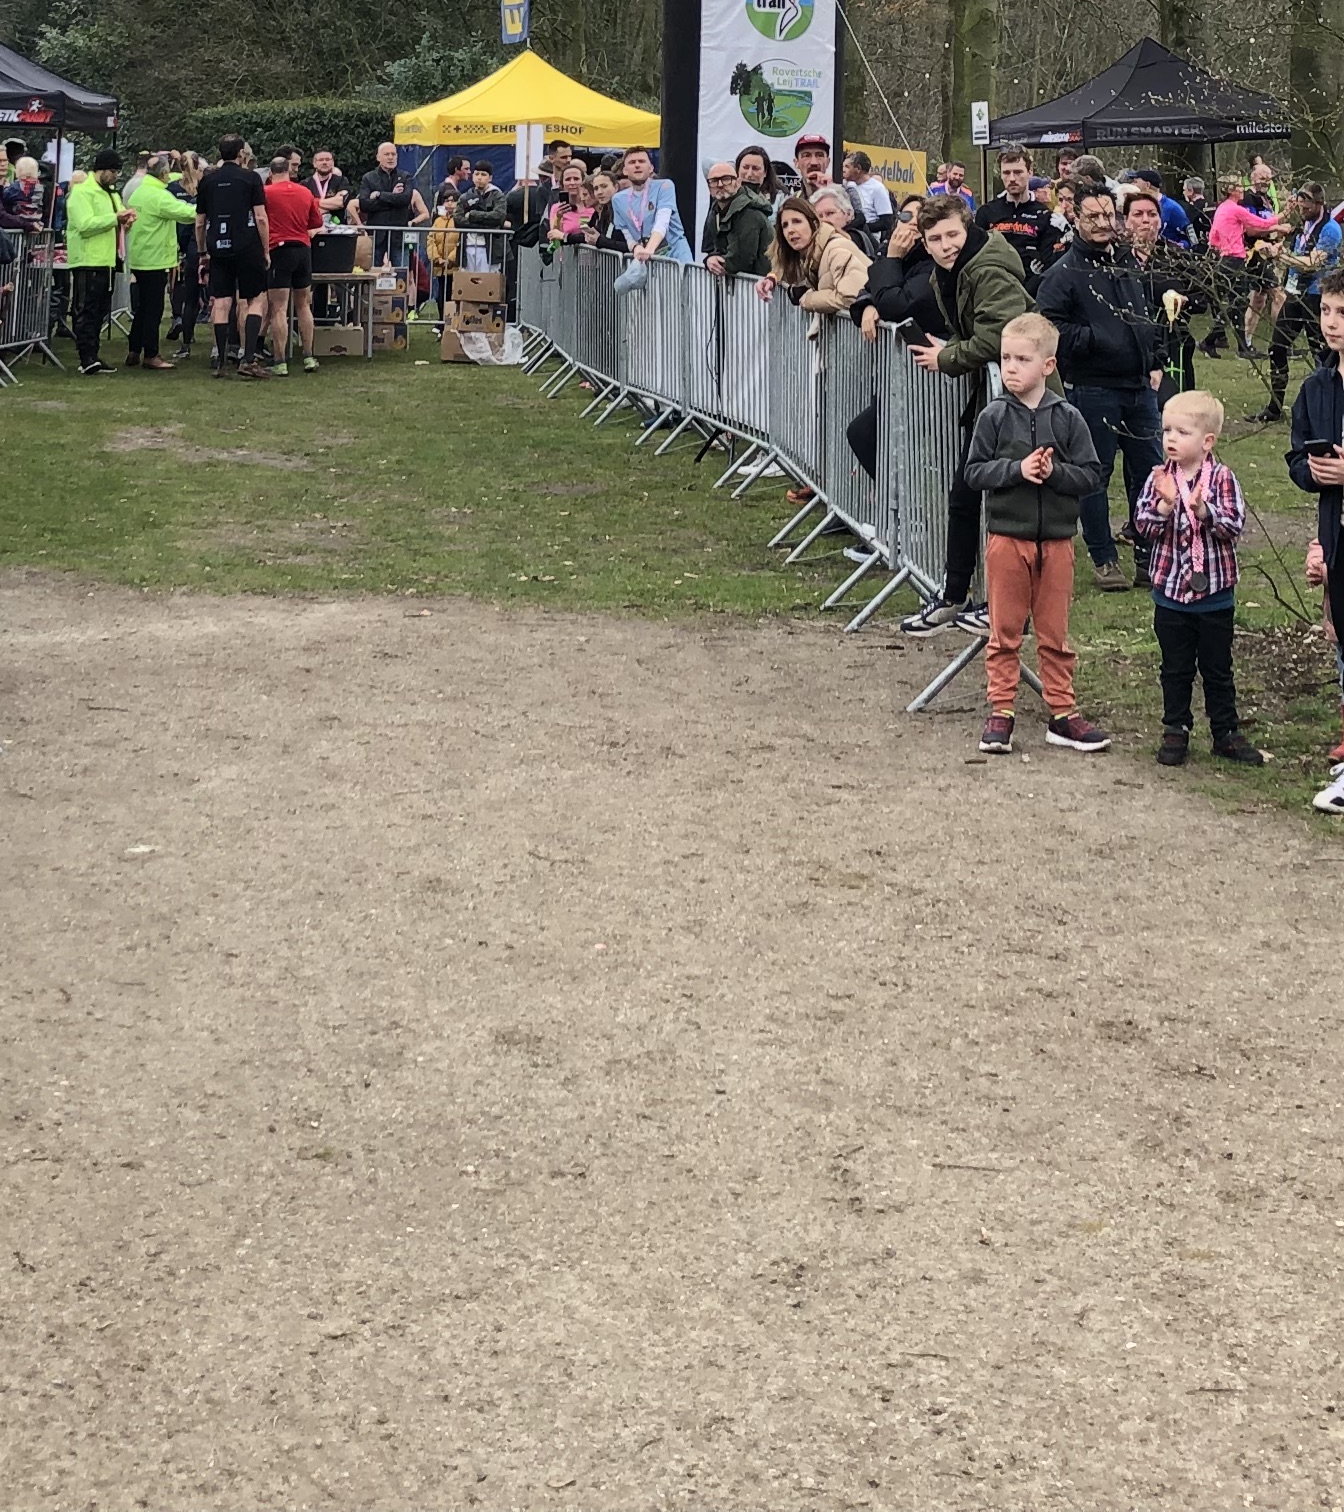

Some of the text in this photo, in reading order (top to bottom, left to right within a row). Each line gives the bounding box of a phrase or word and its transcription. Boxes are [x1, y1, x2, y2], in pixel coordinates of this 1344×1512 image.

[772, 66, 823, 79] Rovertsche
[794, 77, 820, 89] TRAIL
[492, 124, 517, 133] EHB
